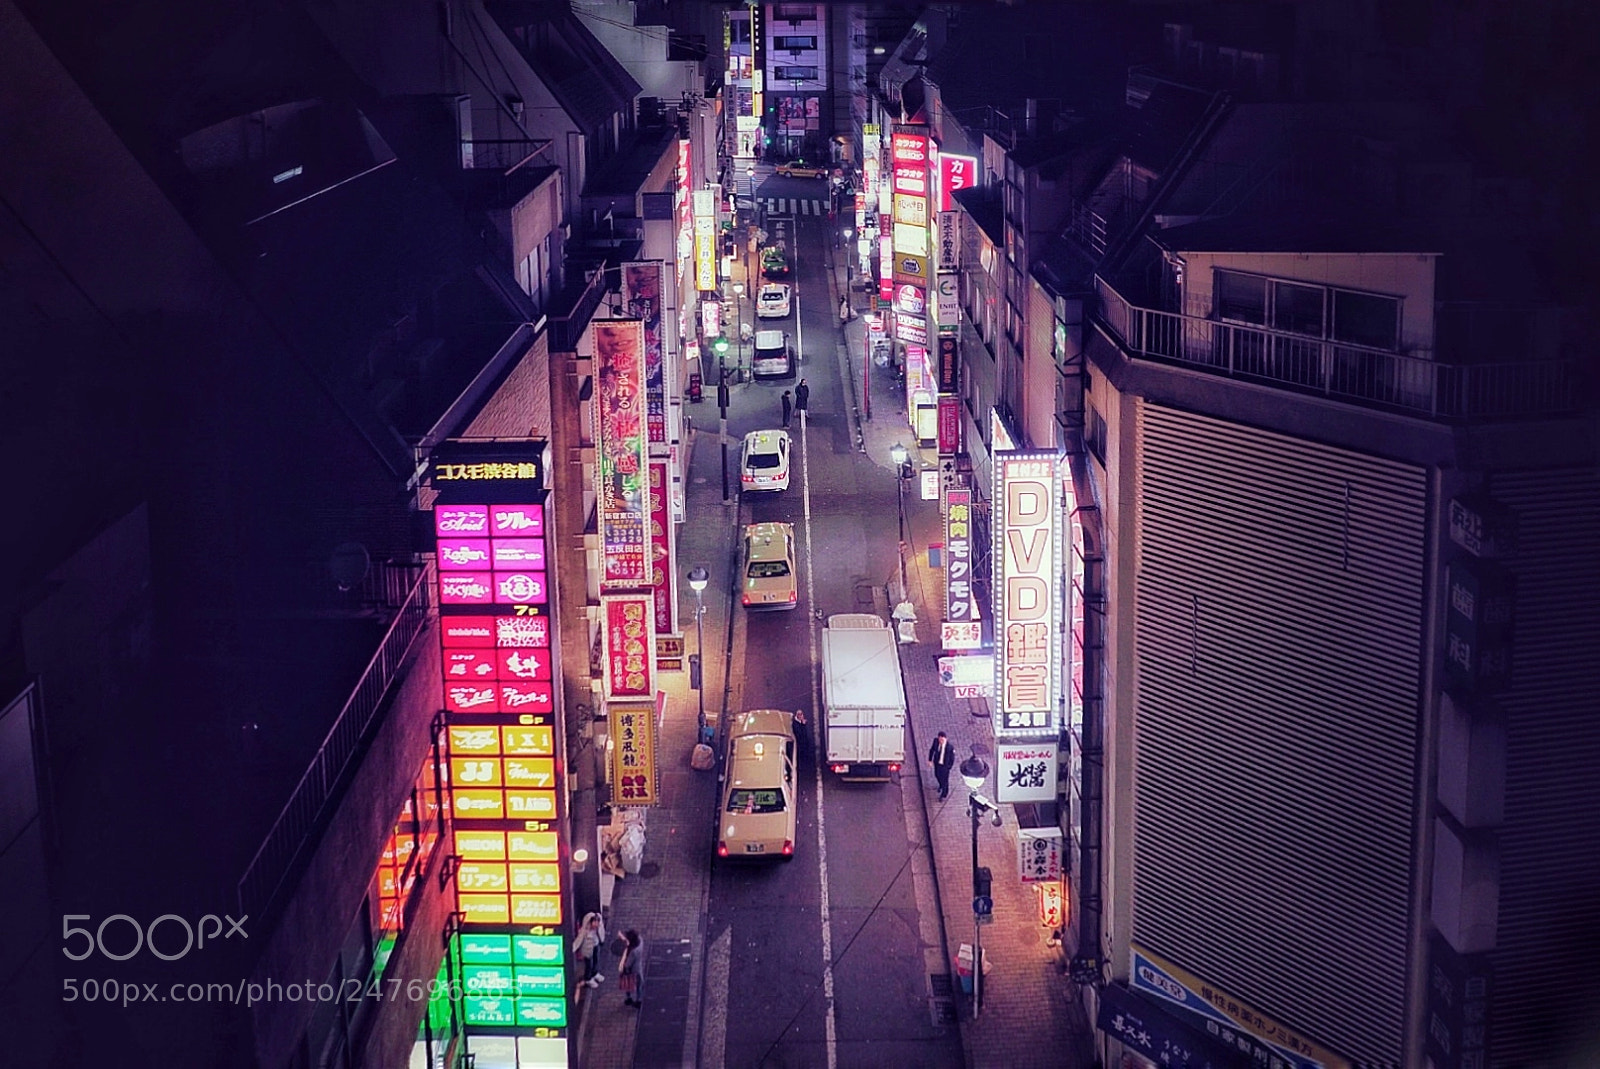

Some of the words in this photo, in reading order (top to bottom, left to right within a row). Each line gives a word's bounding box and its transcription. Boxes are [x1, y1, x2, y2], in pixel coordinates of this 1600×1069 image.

[896, 138, 924, 149] カラオケ
[896, 168, 924, 178] カラオケ
[435, 463, 537, 480] コスモ渋谷館
[500, 579, 541, 596] R&B
[957, 688, 976, 697] VR
[519, 715, 544, 724] 6F
[524, 821, 549, 831] 5F
[461, 873, 505, 887] リアン
[1047, 887, 1058, 925] らーめん
[530, 926, 554, 935] 4F
